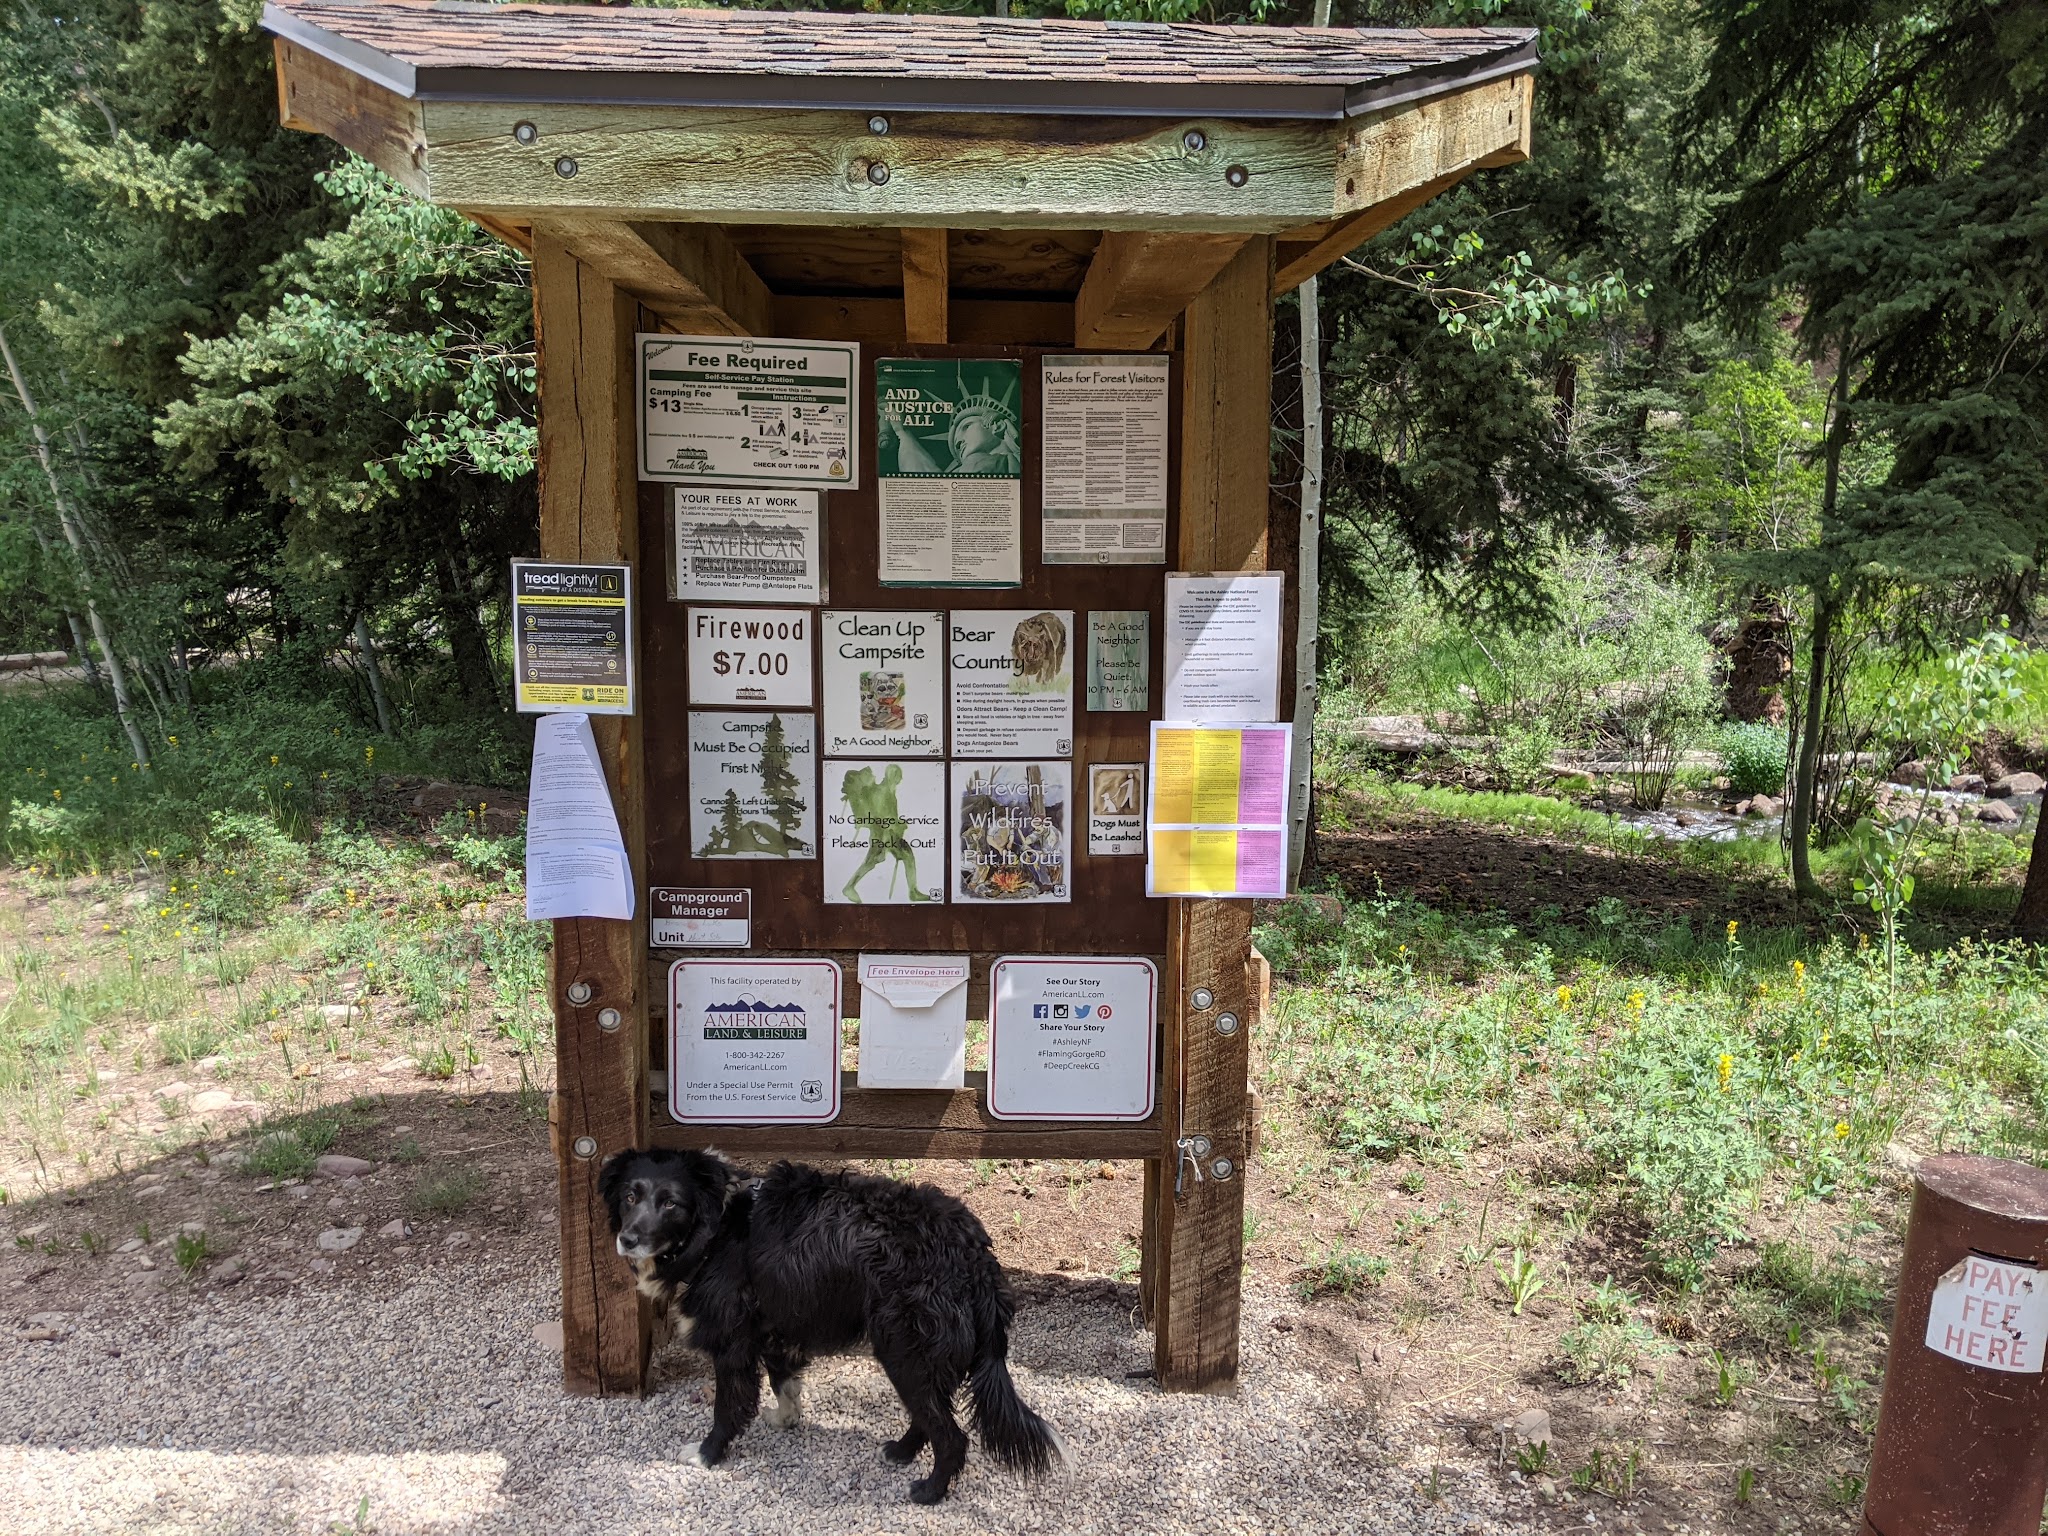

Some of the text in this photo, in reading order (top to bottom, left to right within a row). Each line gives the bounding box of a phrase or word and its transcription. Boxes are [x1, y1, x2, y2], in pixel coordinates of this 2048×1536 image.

[645, 340, 673, 360] Welcome!
[688, 352, 808, 372] Fee Required
[704, 373, 795, 384] Self-Service Pay Station
[1045, 371, 1166, 385] Rules for Forest Visitors
[649, 387, 712, 398] Camping Fee
[772, 394, 817, 402] Instructions
[884, 388, 920, 400] AND
[741, 404, 749, 417] 1
[792, 406, 802, 419] 3
[884, 401, 954, 414] JUSTICE
[903, 414, 934, 427] ALL
[740, 436, 751, 449] 2
[790, 431, 801, 443] 4
[666, 459, 716, 474] Thank You
[753, 461, 777, 469] CHECK
[778, 462, 792, 470] OUT
[809, 463, 820, 471] PM
[681, 494, 798, 507] YOUR FEES AT WORK
[695, 572, 796, 583] Purchase Bear-Proof Dumpsters
[695, 580, 721, 589] Replace
[742, 582, 761, 590] Pump
[696, 615, 803, 641] Firewood
[838, 615, 925, 646] Clean Up
[1092, 620, 1144, 631] Be A Good
[952, 626, 996, 642] Bear
[1097, 633, 1140, 648] Neighbor
[839, 642, 925, 669] Campsite
[712, 649, 788, 677] $7.00
[952, 654, 1025, 677] Country
[1096, 657, 1141, 668] Please Be
[1088, 686, 1098, 694] 10
[1099, 686, 1115, 694] PM
[1123, 684, 1129, 694] 6
[1130, 686, 1147, 694] AM
[1013, 706, 1028, 714] Keep
[834, 734, 932, 750] Be A Good Neighbor
[971, 740, 1002, 748] Antagonize
[694, 739, 810, 759] Must Be Occupied
[721, 762, 748, 774] First
[974, 779, 1049, 796] Prevent
[742, 796, 758, 806] Left
[736, 807, 760, 815] Hours
[829, 811, 939, 829] No Garbage Service
[969, 806, 1053, 829] Wildfires
[1092, 819, 1140, 831] Dogs Must
[832, 835, 869, 848] Please
[871, 836, 897, 848] Pack
[910, 838, 936, 848] Out!
[1090, 830, 1142, 842] Be Leashed
[963, 849, 1061, 865] Put It Out
[658, 890, 743, 905] Campground
[671, 904, 729, 918] Manager
[659, 931, 685, 942] Unit
[872, 967, 960, 977] Fee Envelope Here
[710, 977, 802, 987] This facility operated by
[1046, 977, 1101, 988] See Our Story
[1042, 990, 1105, 999] AmericanLL.com
[704, 1013, 807, 1028] AMERICAN
[706, 1029, 803, 1039] LAND & LEISURE
[1039, 1023, 1105, 1034] Share Your Story
[1052, 1038, 1092, 1048] #AshleyNF
[725, 1051, 785, 1059] 1-800-342-2267
[1037, 1050, 1107, 1060] #FlamingGorgeRD
[723, 1063, 788, 1071] AmericanLL.com
[1043, 1062, 1100, 1072] #DeepCreekCG
[686, 1081, 711, 1089] Under
[720, 1081, 749, 1091] Special
[750, 1081, 765, 1089] Use
[767, 1081, 794, 1089] Permit
[686, 1093, 797, 1101] From the U.S. Forest Service
[1970, 1262, 2023, 1296] PAY
[1963, 1295, 2021, 1332] FEE
[1945, 1324, 2028, 1367] HERE
